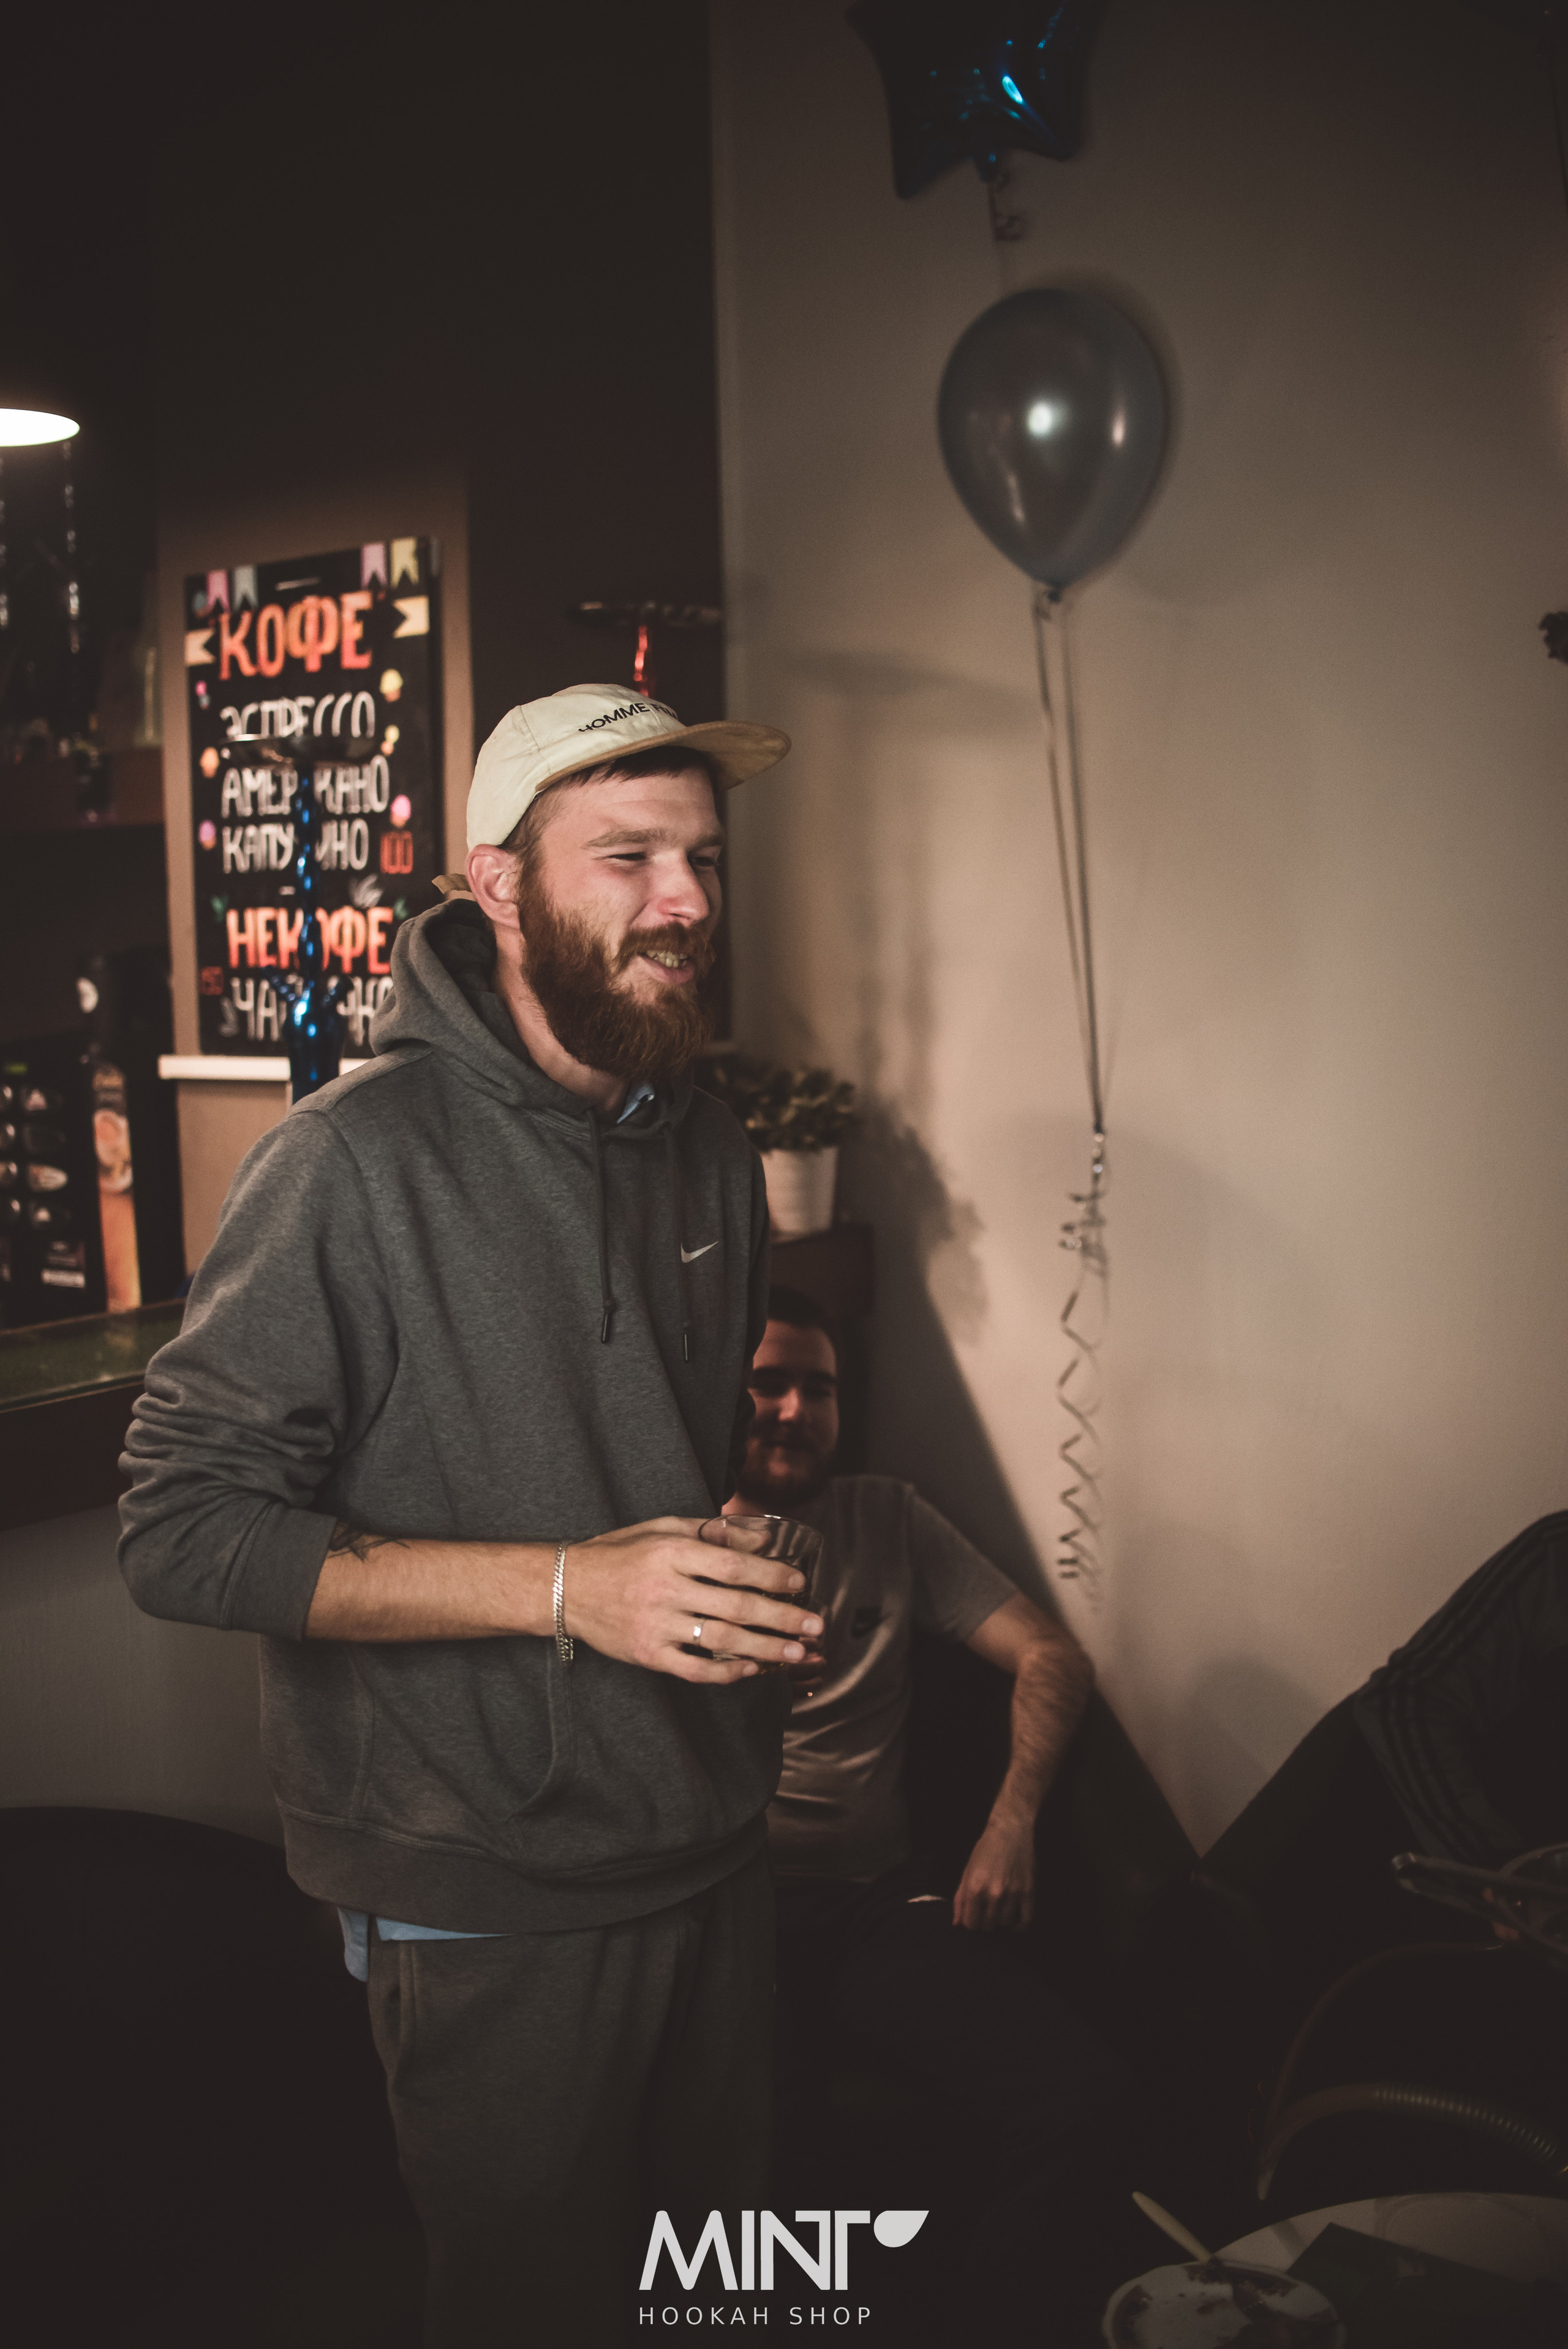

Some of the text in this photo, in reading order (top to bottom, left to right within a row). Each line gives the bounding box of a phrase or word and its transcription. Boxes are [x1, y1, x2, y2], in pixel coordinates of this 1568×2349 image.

[218, 590, 373, 681] КОФЕ
[221, 754, 390, 819] АМЕРКАНО
[221, 817, 369, 874] КАПУИНО
